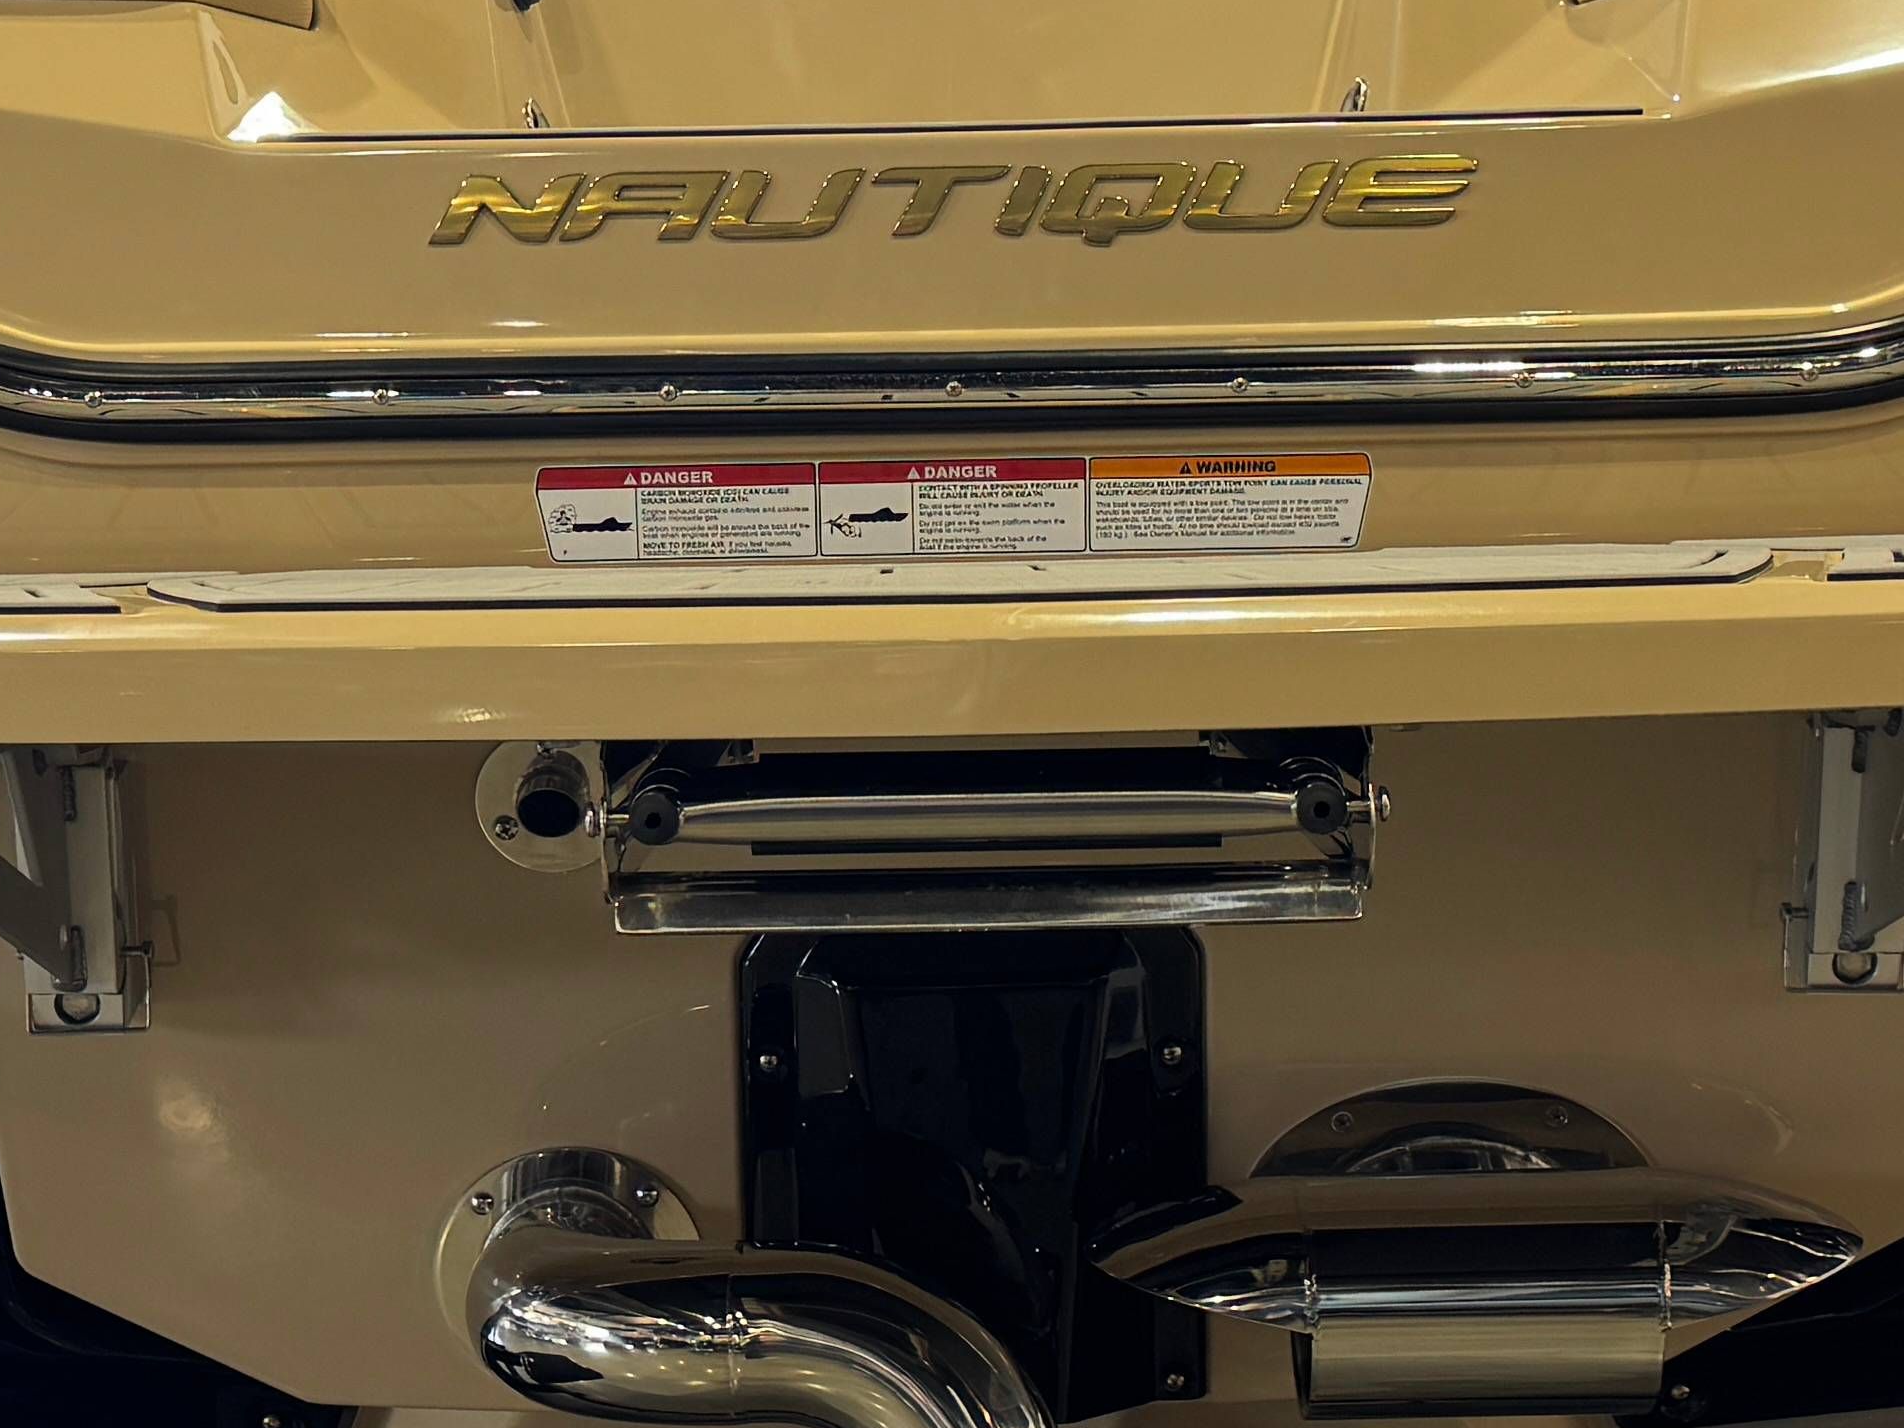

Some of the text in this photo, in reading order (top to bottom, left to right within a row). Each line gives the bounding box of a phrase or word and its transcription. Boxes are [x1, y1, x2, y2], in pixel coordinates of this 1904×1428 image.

[427, 153, 1479, 247] NAUTIQUE
[924, 465, 997, 479] DANGER
[1196, 460, 1276, 474] WARNING
[640, 471, 713, 484] DANGER
